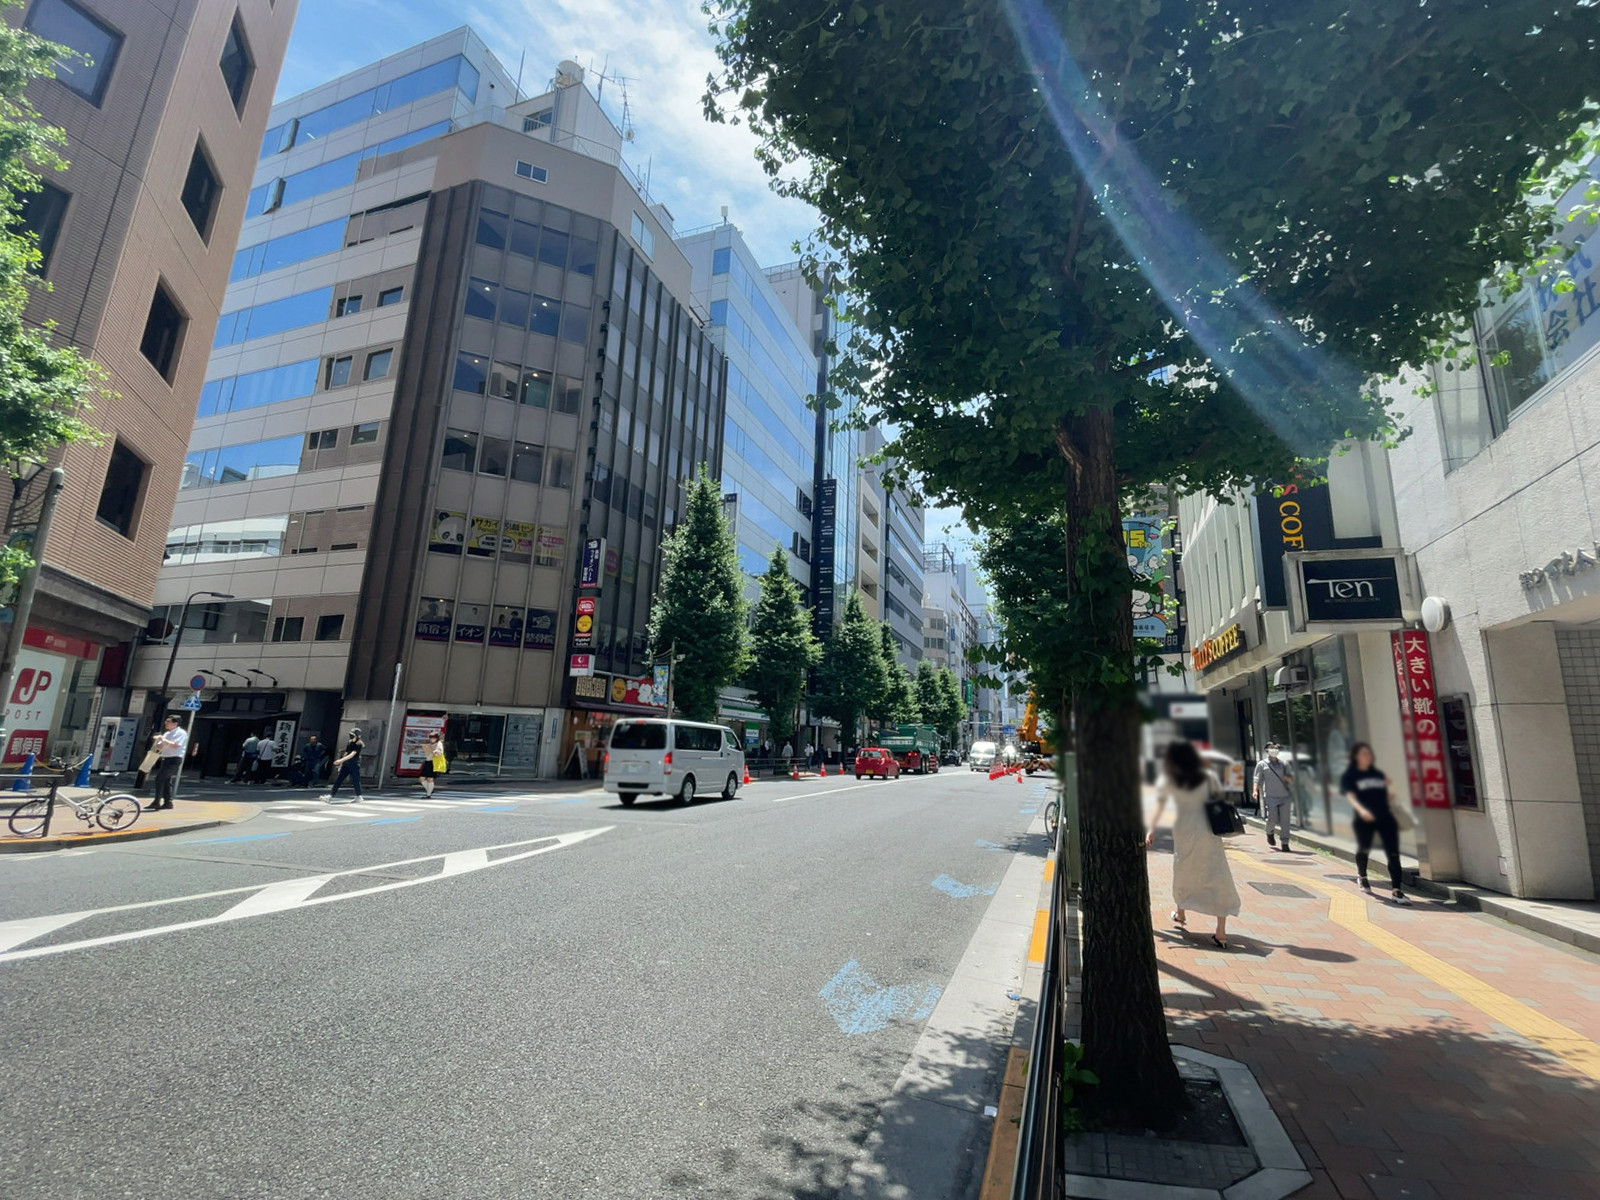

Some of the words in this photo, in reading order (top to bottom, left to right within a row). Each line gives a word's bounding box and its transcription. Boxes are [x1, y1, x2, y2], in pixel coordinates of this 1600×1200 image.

[1306, 576, 1393, 599] Ten
[1212, 623, 1239, 660] COFFEE
[1405, 637, 1446, 801] 大きい靴の専門店
[10, 737, 43, 756] 郵便局
